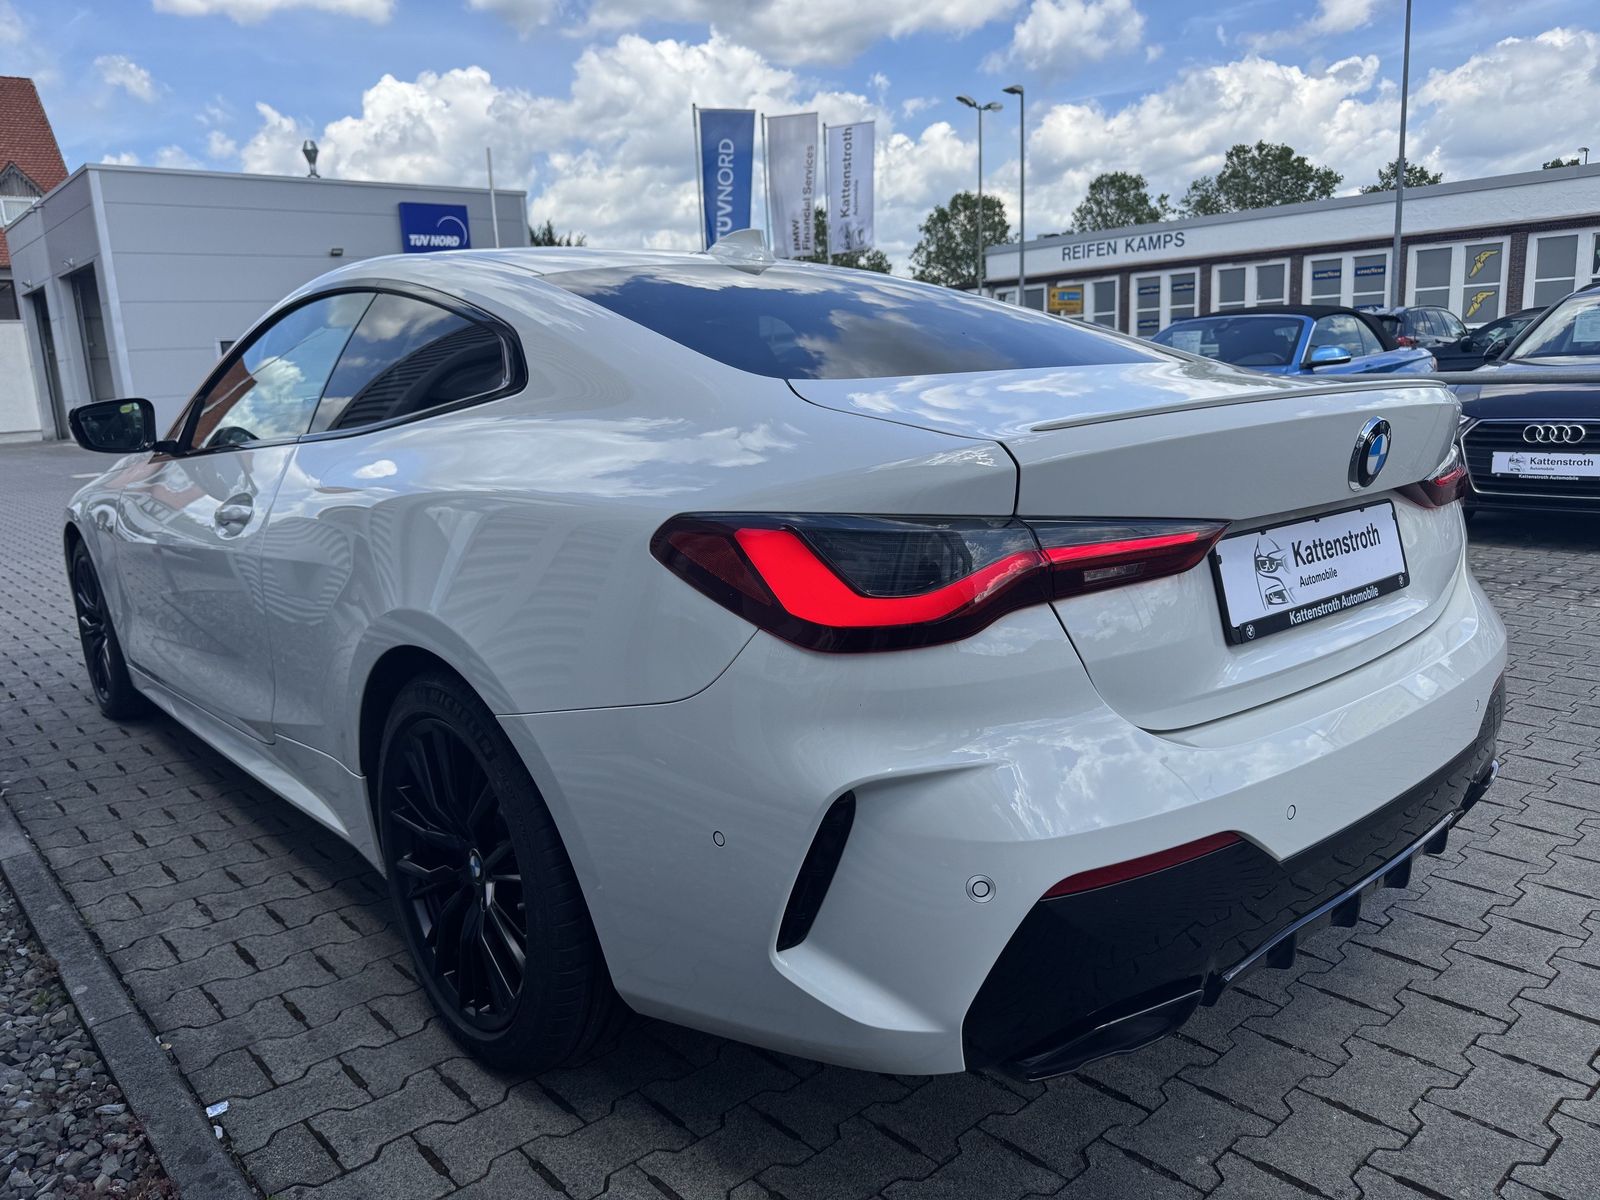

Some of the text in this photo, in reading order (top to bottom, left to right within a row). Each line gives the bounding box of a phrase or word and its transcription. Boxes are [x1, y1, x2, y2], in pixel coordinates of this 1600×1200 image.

[841, 127, 853, 218] Kattenstroth
[802, 144, 815, 251] Financial Services
[430, 235, 460, 247] NORD
[792, 219, 801, 251] BMW
[1062, 231, 1185, 262] REIFEN KAMPS
[1529, 456, 1594, 467] Kattenstroth
[1291, 523, 1381, 568] Kattenstroth
[1299, 567, 1338, 588] Automobile
[1289, 585, 1379, 625] Kattenstroth Automobile
